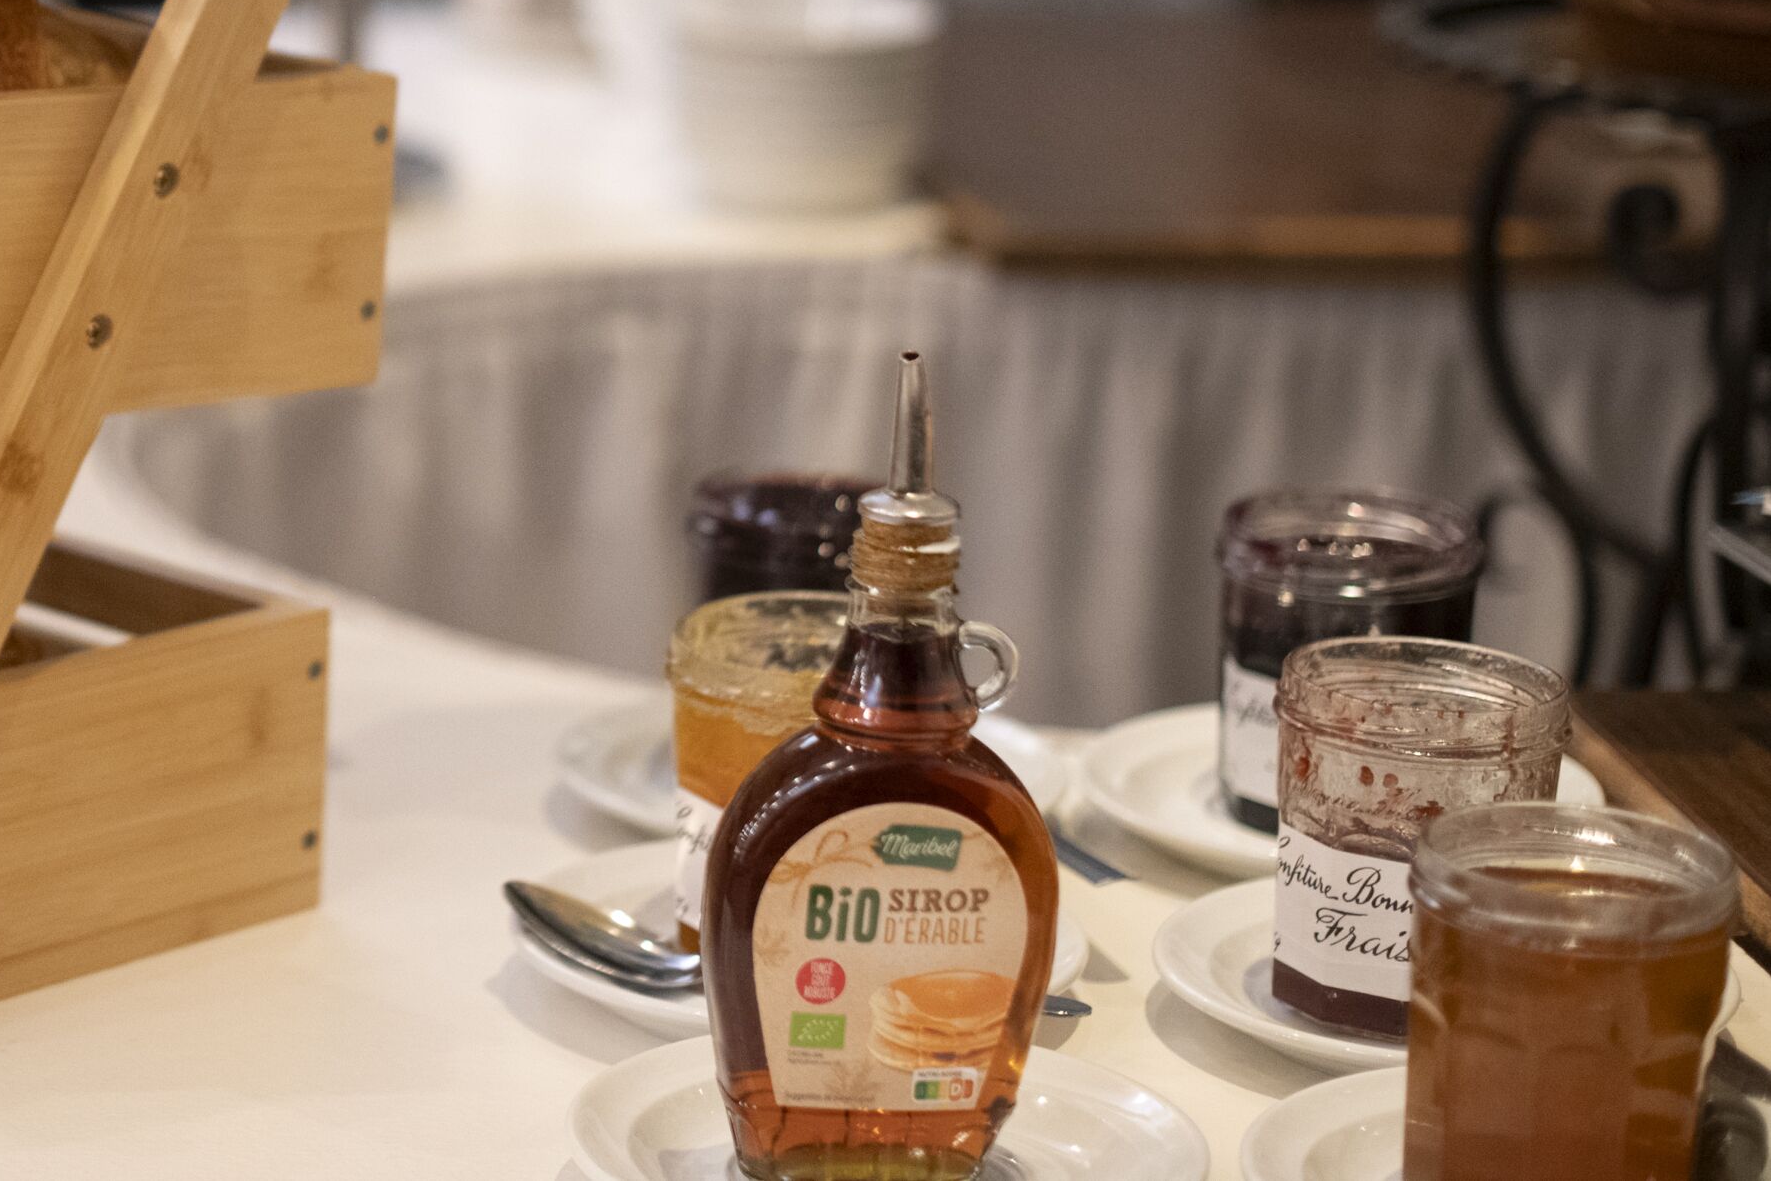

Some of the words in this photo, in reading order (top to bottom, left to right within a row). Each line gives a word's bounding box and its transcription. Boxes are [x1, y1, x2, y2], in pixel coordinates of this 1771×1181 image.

[880, 832, 959, 860] Maribel
[887, 888, 990, 913] SIROP
[1342, 866, 1413, 914] Bonn
[883, 913, 987, 945] D'ÉRABLE
[1313, 907, 1411, 962] Frais
